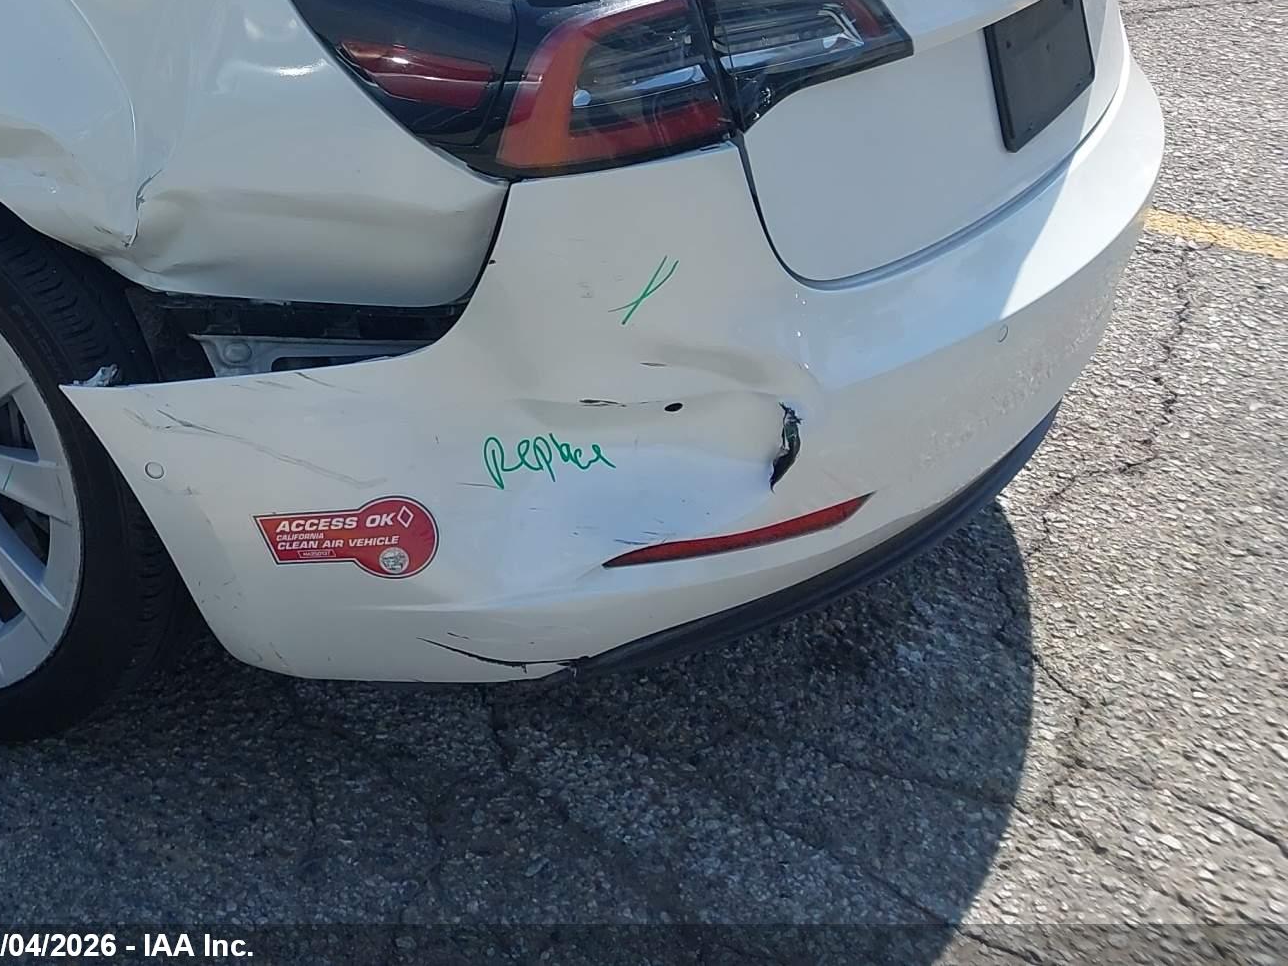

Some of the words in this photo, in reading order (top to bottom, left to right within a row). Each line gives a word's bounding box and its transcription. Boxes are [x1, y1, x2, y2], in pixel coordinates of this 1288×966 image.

[275, 516, 359, 533] ACCESS
[365, 512, 397, 528] OK
[275, 532, 325, 542] CALIFORNIA
[277, 539, 319, 551] CLEAN
[321, 538, 344, 549] AIR
[348, 535, 400, 548] VEHICLE
